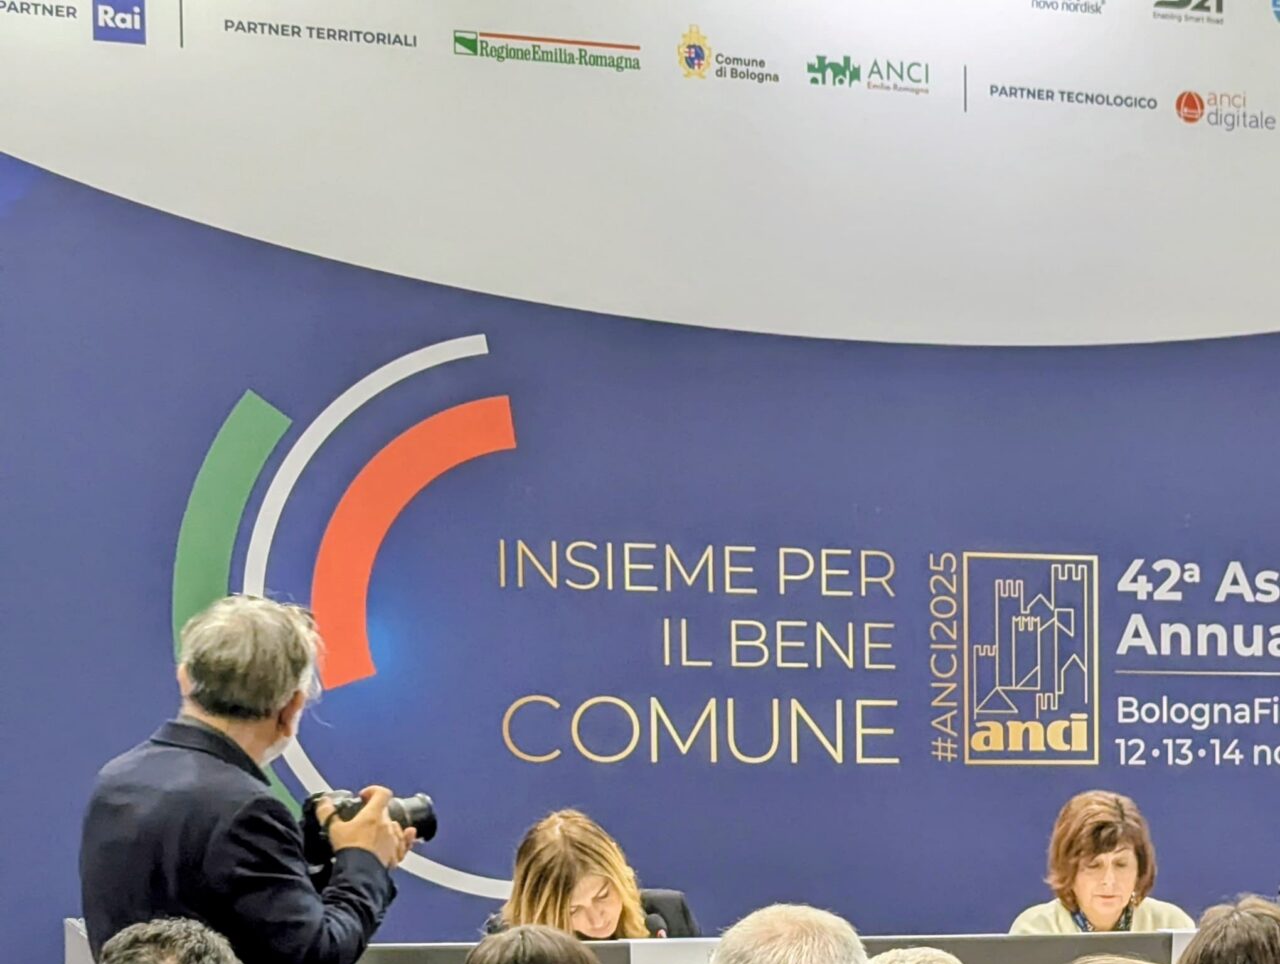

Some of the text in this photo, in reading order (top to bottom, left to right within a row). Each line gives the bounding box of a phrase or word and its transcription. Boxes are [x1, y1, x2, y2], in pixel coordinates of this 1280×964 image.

[97, 5, 141, 30] Rai
[1061, 1, 1102, 14] nordisk
[224, 19, 417, 48] PARTNER TERRITORIALI
[715, 53, 766, 69] Comune
[868, 58, 930, 84] ANCI
[715, 68, 780, 84] di Bologna
[989, 85, 1158, 110] PARTNER TECNOLOGICO
[1207, 90, 1247, 108] anci
[1207, 109, 1277, 131] digitale
[498, 538, 896, 597] INSIEME PER
[663, 618, 896, 670] IL BENE
[929, 551, 958, 762] #ANCI2025
[502, 695, 900, 764] COMUNE
[970, 713, 1088, 752] anci
